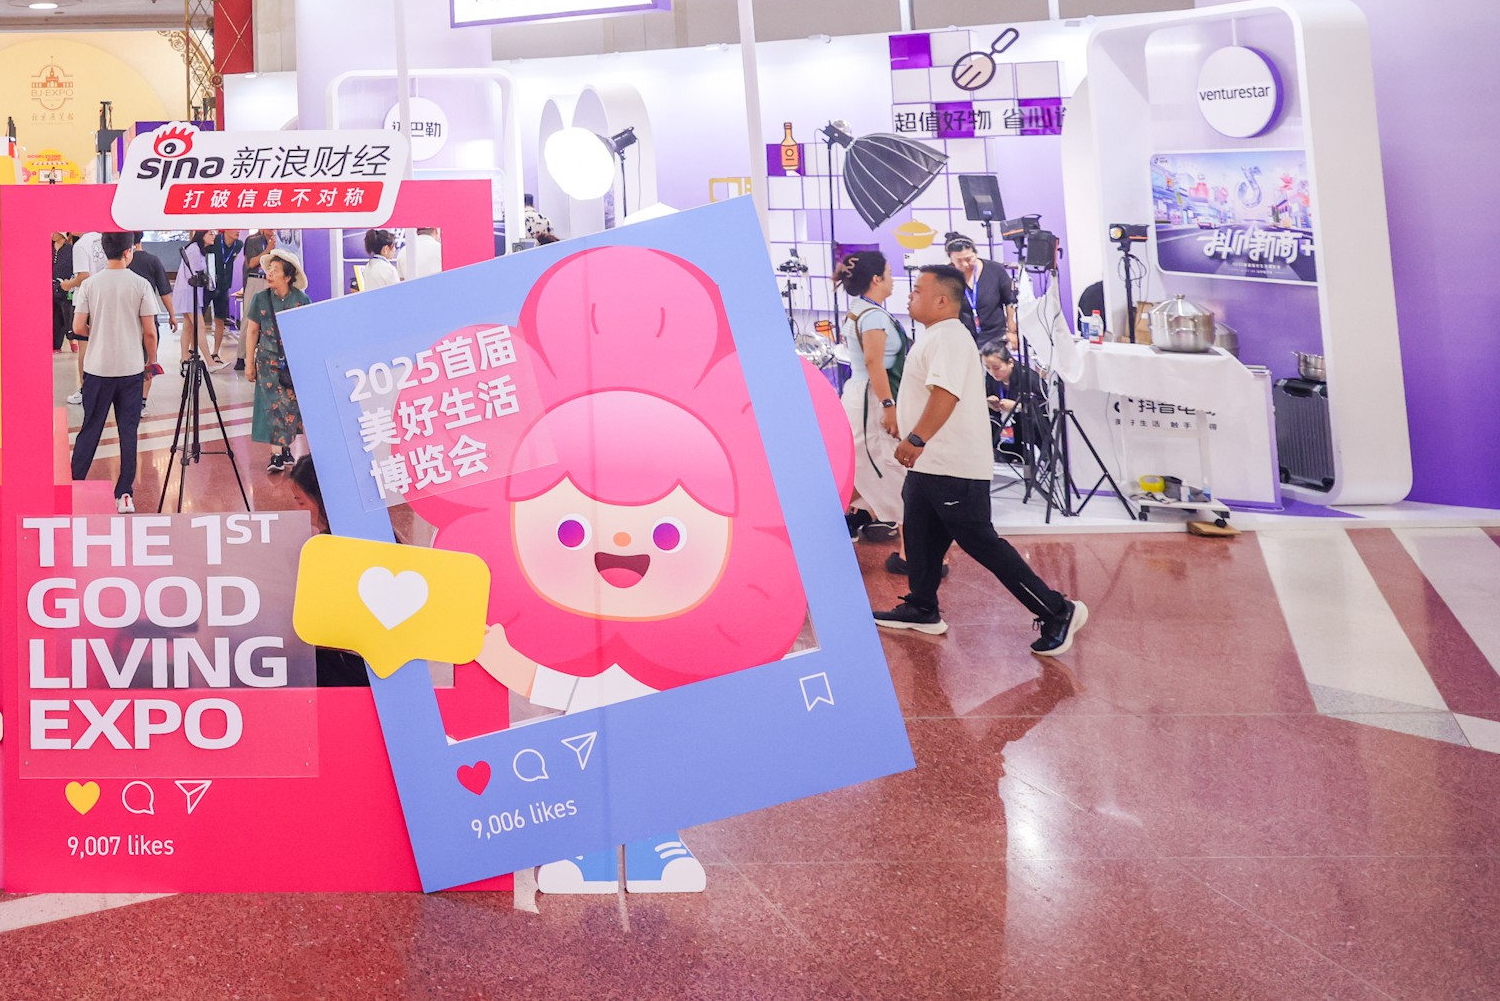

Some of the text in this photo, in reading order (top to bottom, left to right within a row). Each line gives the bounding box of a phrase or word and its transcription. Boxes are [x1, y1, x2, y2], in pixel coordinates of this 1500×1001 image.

[1199, 85, 1271, 102] venturestar
[894, 110, 991, 133] 超值好物
[137, 144, 391, 190] sina 新浪财经
[183, 188, 365, 209] 打破信息不对称
[345, 325, 517, 403] 2025首届
[358, 374, 520, 453] 美好生活
[370, 434, 489, 499] 博览会
[22, 513, 279, 567] THE 1ST
[27, 576, 260, 628] GOOD
[29, 636, 288, 689] LIVING
[30, 698, 243, 750] EXPO
[471, 800, 578, 840] 9,006 likes
[67, 835, 175, 859] 9,007 likes
